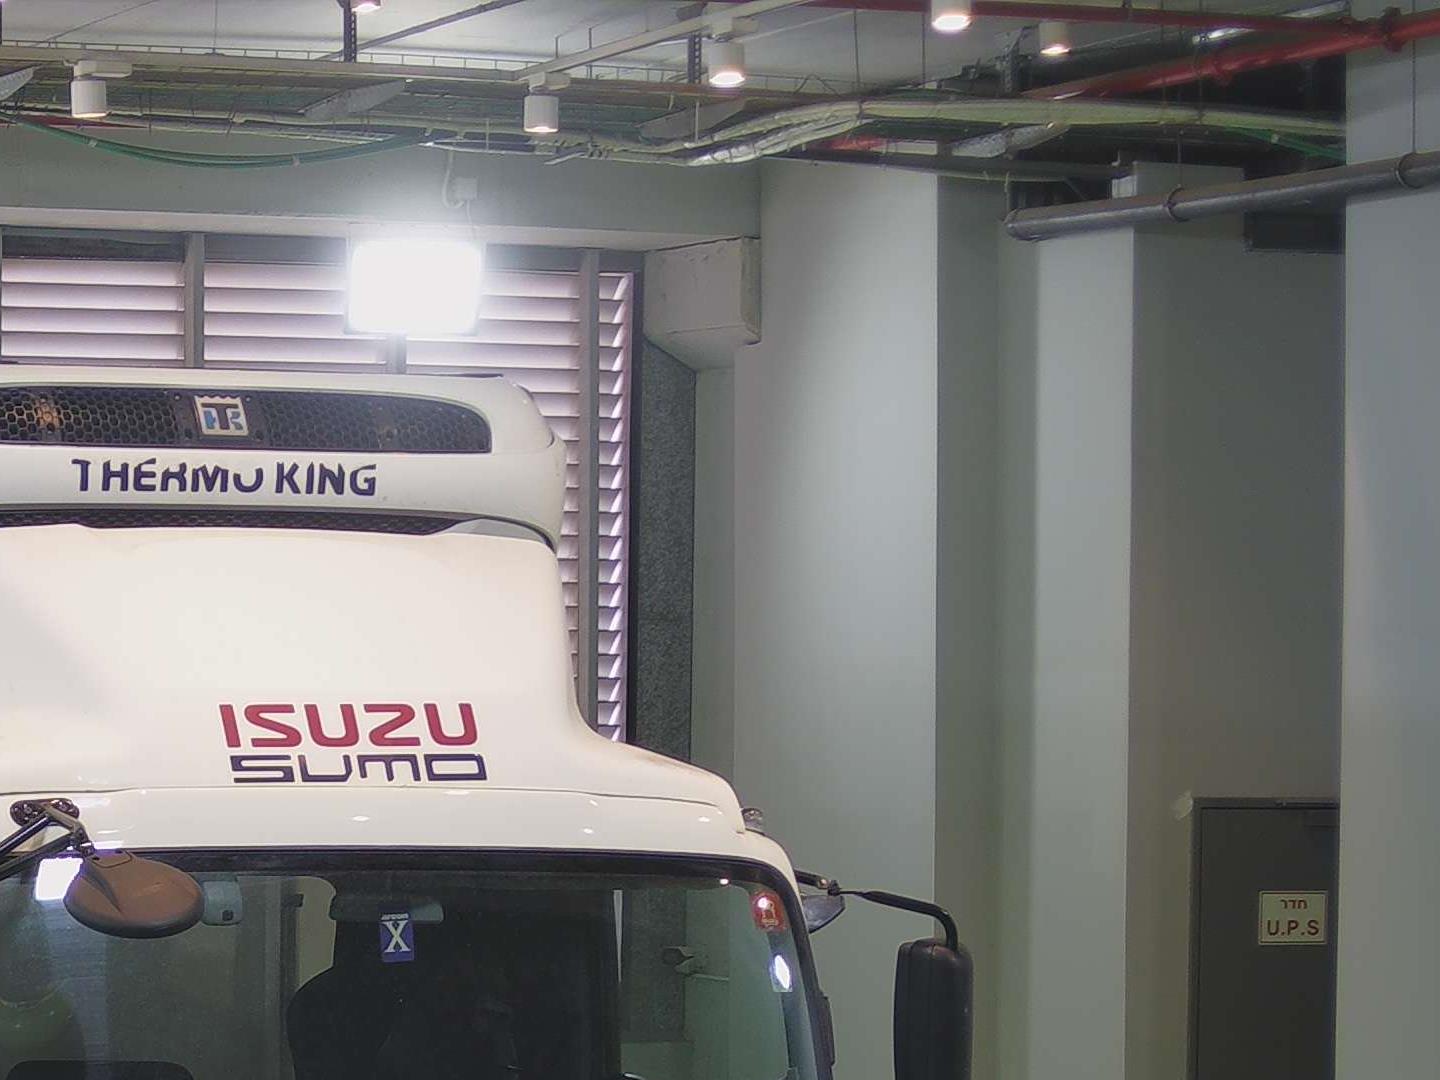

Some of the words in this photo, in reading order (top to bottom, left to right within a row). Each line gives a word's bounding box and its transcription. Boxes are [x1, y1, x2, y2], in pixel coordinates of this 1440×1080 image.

[275, 461, 377, 496] KING
[218, 702, 478, 748] ISUZU
[229, 753, 487, 783] SUMO
[1280, 899, 1307, 909] חדר
[1266, 919, 1320, 936] U.P.S
